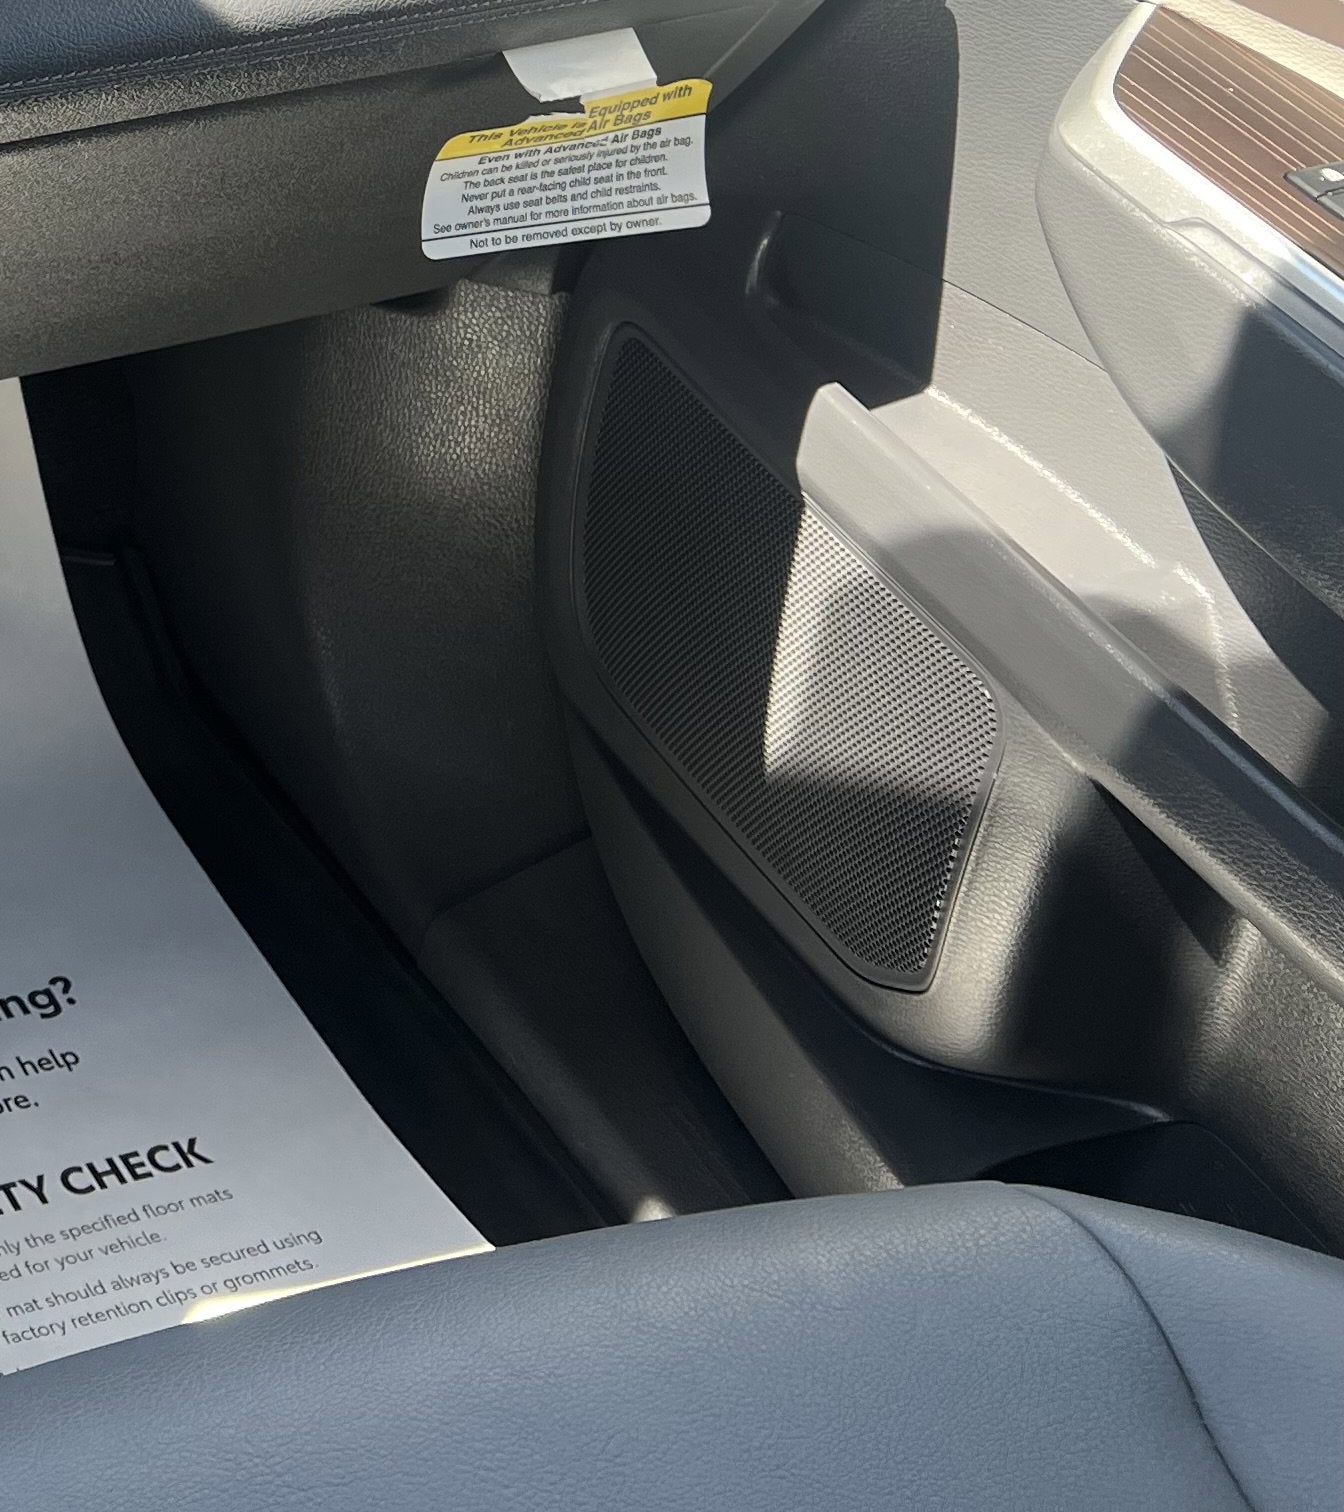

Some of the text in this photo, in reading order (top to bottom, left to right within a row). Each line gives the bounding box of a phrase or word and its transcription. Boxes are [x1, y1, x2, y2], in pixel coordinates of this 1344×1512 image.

[469, 132, 503, 144] This
[509, 123, 569, 137] Vehicle
[588, 92, 660, 119] Equipped
[662, 84, 693, 103] with
[500, 110, 653, 148] Advanced Air Bags
[478, 153, 510, 165] Even
[514, 147, 541, 160] with
[611, 133, 629, 144] Air
[631, 126, 662, 141] Bags
[469, 216, 663, 249] Not to be removed except by owner.
[16, 1049, 80, 1076] help
[60, 1137, 214, 1195] CHECK
[24, 1232, 56, 1249] the
[59, 1208, 141, 1241] specified
[142, 1199, 185, 1218] floor
[189, 1188, 233, 1208] mats
[6, 1298, 43, 1318] mat
[45, 1279, 108, 1308] should
[110, 1266, 170, 1291] always
[170, 1259, 198, 1276] be
[200, 1239, 270, 1268] secured
[273, 1229, 323, 1252] using
[24, 1258, 50, 1275] for
[54, 1248, 94, 1271] your
[98, 1231, 167, 1257] vehicle.
[2, 1320, 66, 1345] factory
[70, 1298, 153, 1330] retention
[155, 1286, 198, 1308] clips
[200, 1281, 218, 1296] or
[222, 1258, 320, 1293] grommets.
